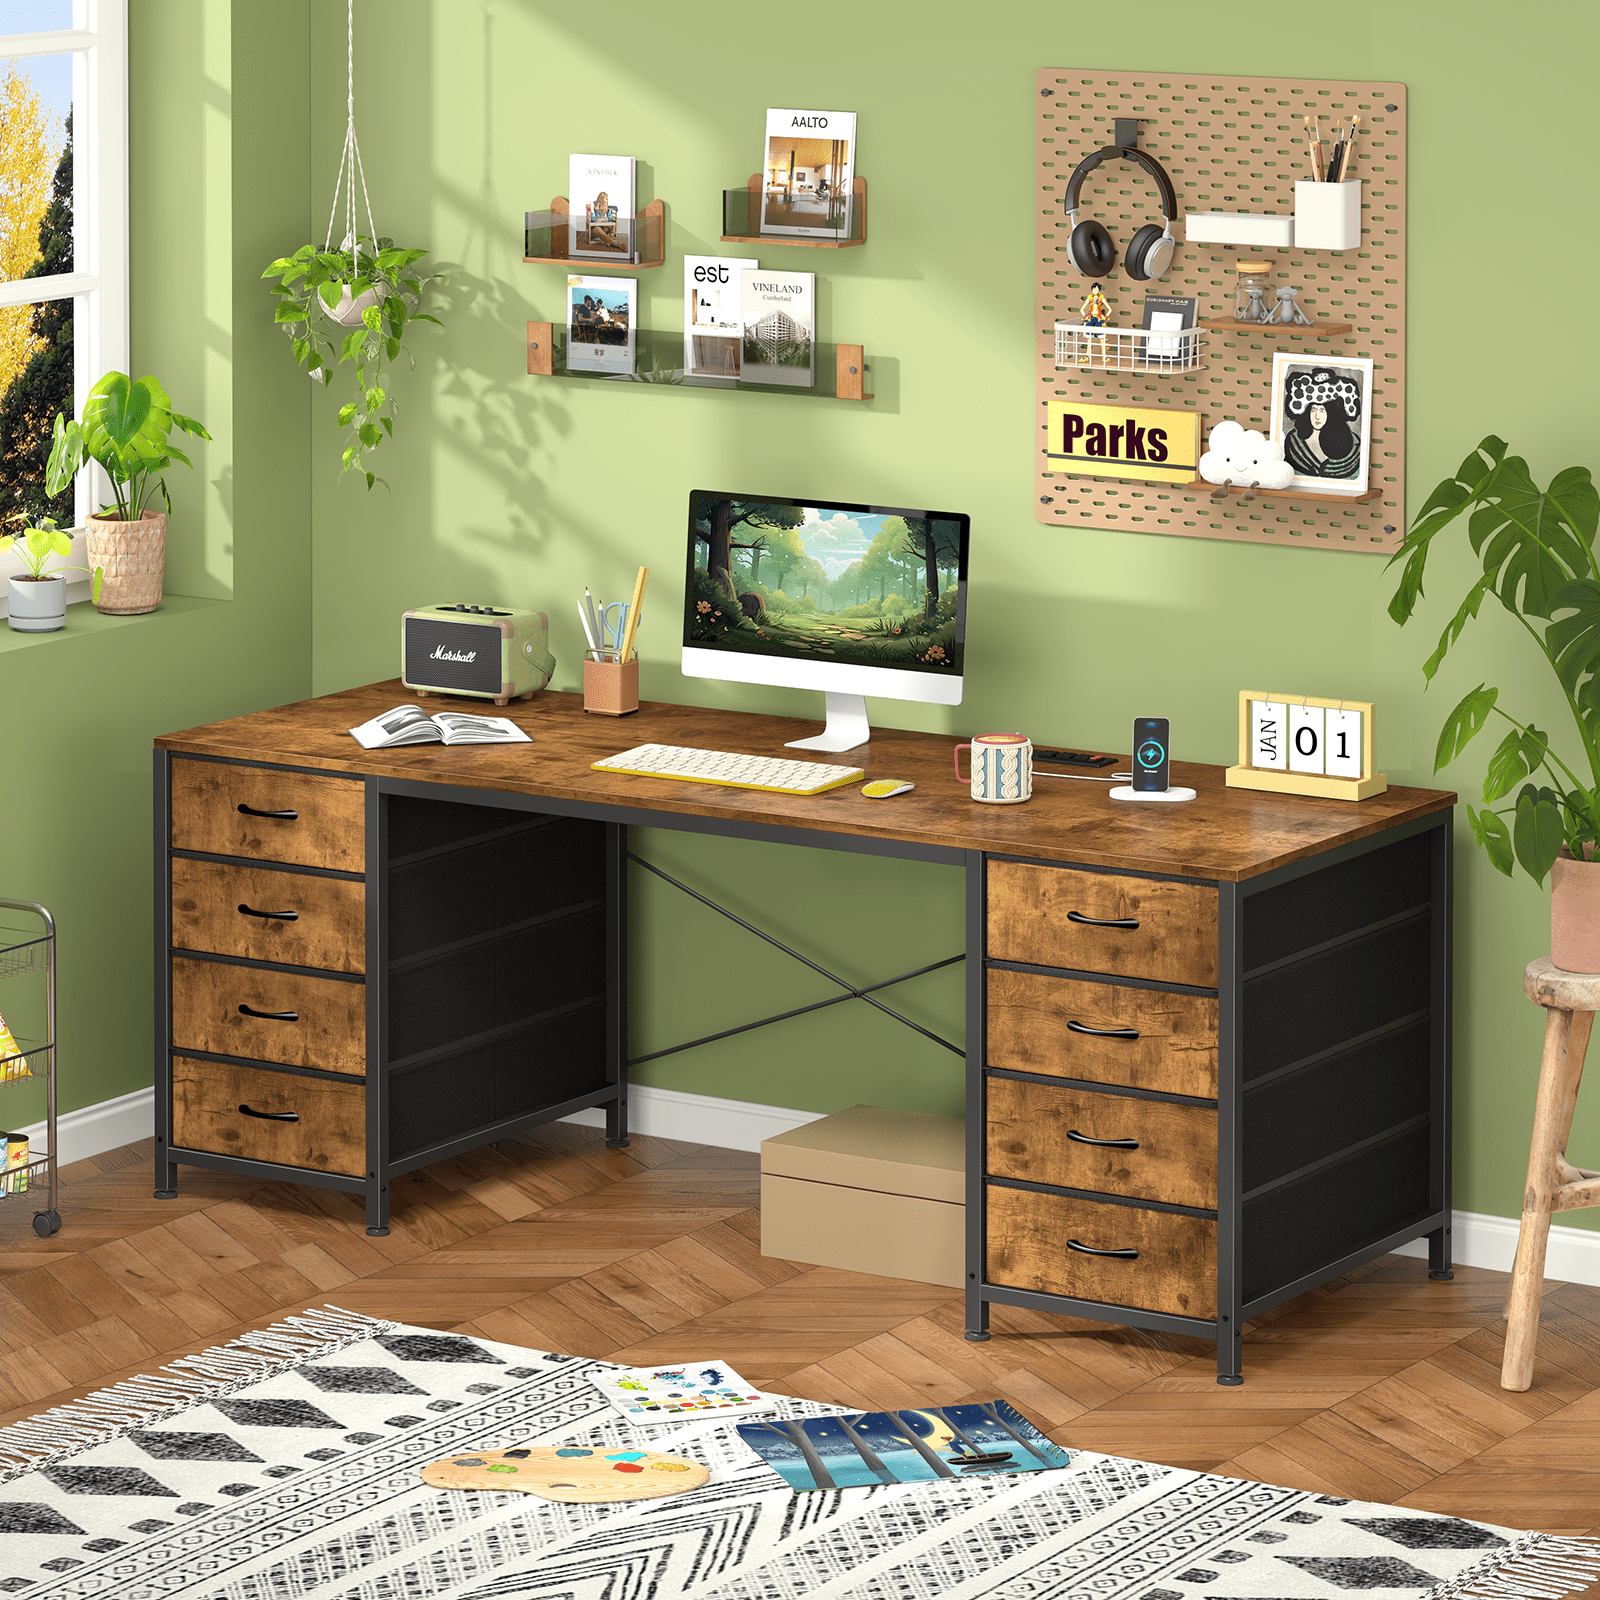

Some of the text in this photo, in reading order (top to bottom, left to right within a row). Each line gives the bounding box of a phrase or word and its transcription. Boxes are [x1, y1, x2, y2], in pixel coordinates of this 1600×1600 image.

[791, 115, 828, 129] AALTO
[694, 263, 729, 284] est
[752, 283, 803, 294] VINELAND
[762, 294, 792, 303] Cumberland
[1063, 413, 1168, 462] Parks
[430, 645, 477, 662] Marshall
[1260, 719, 1277, 761] JAN
